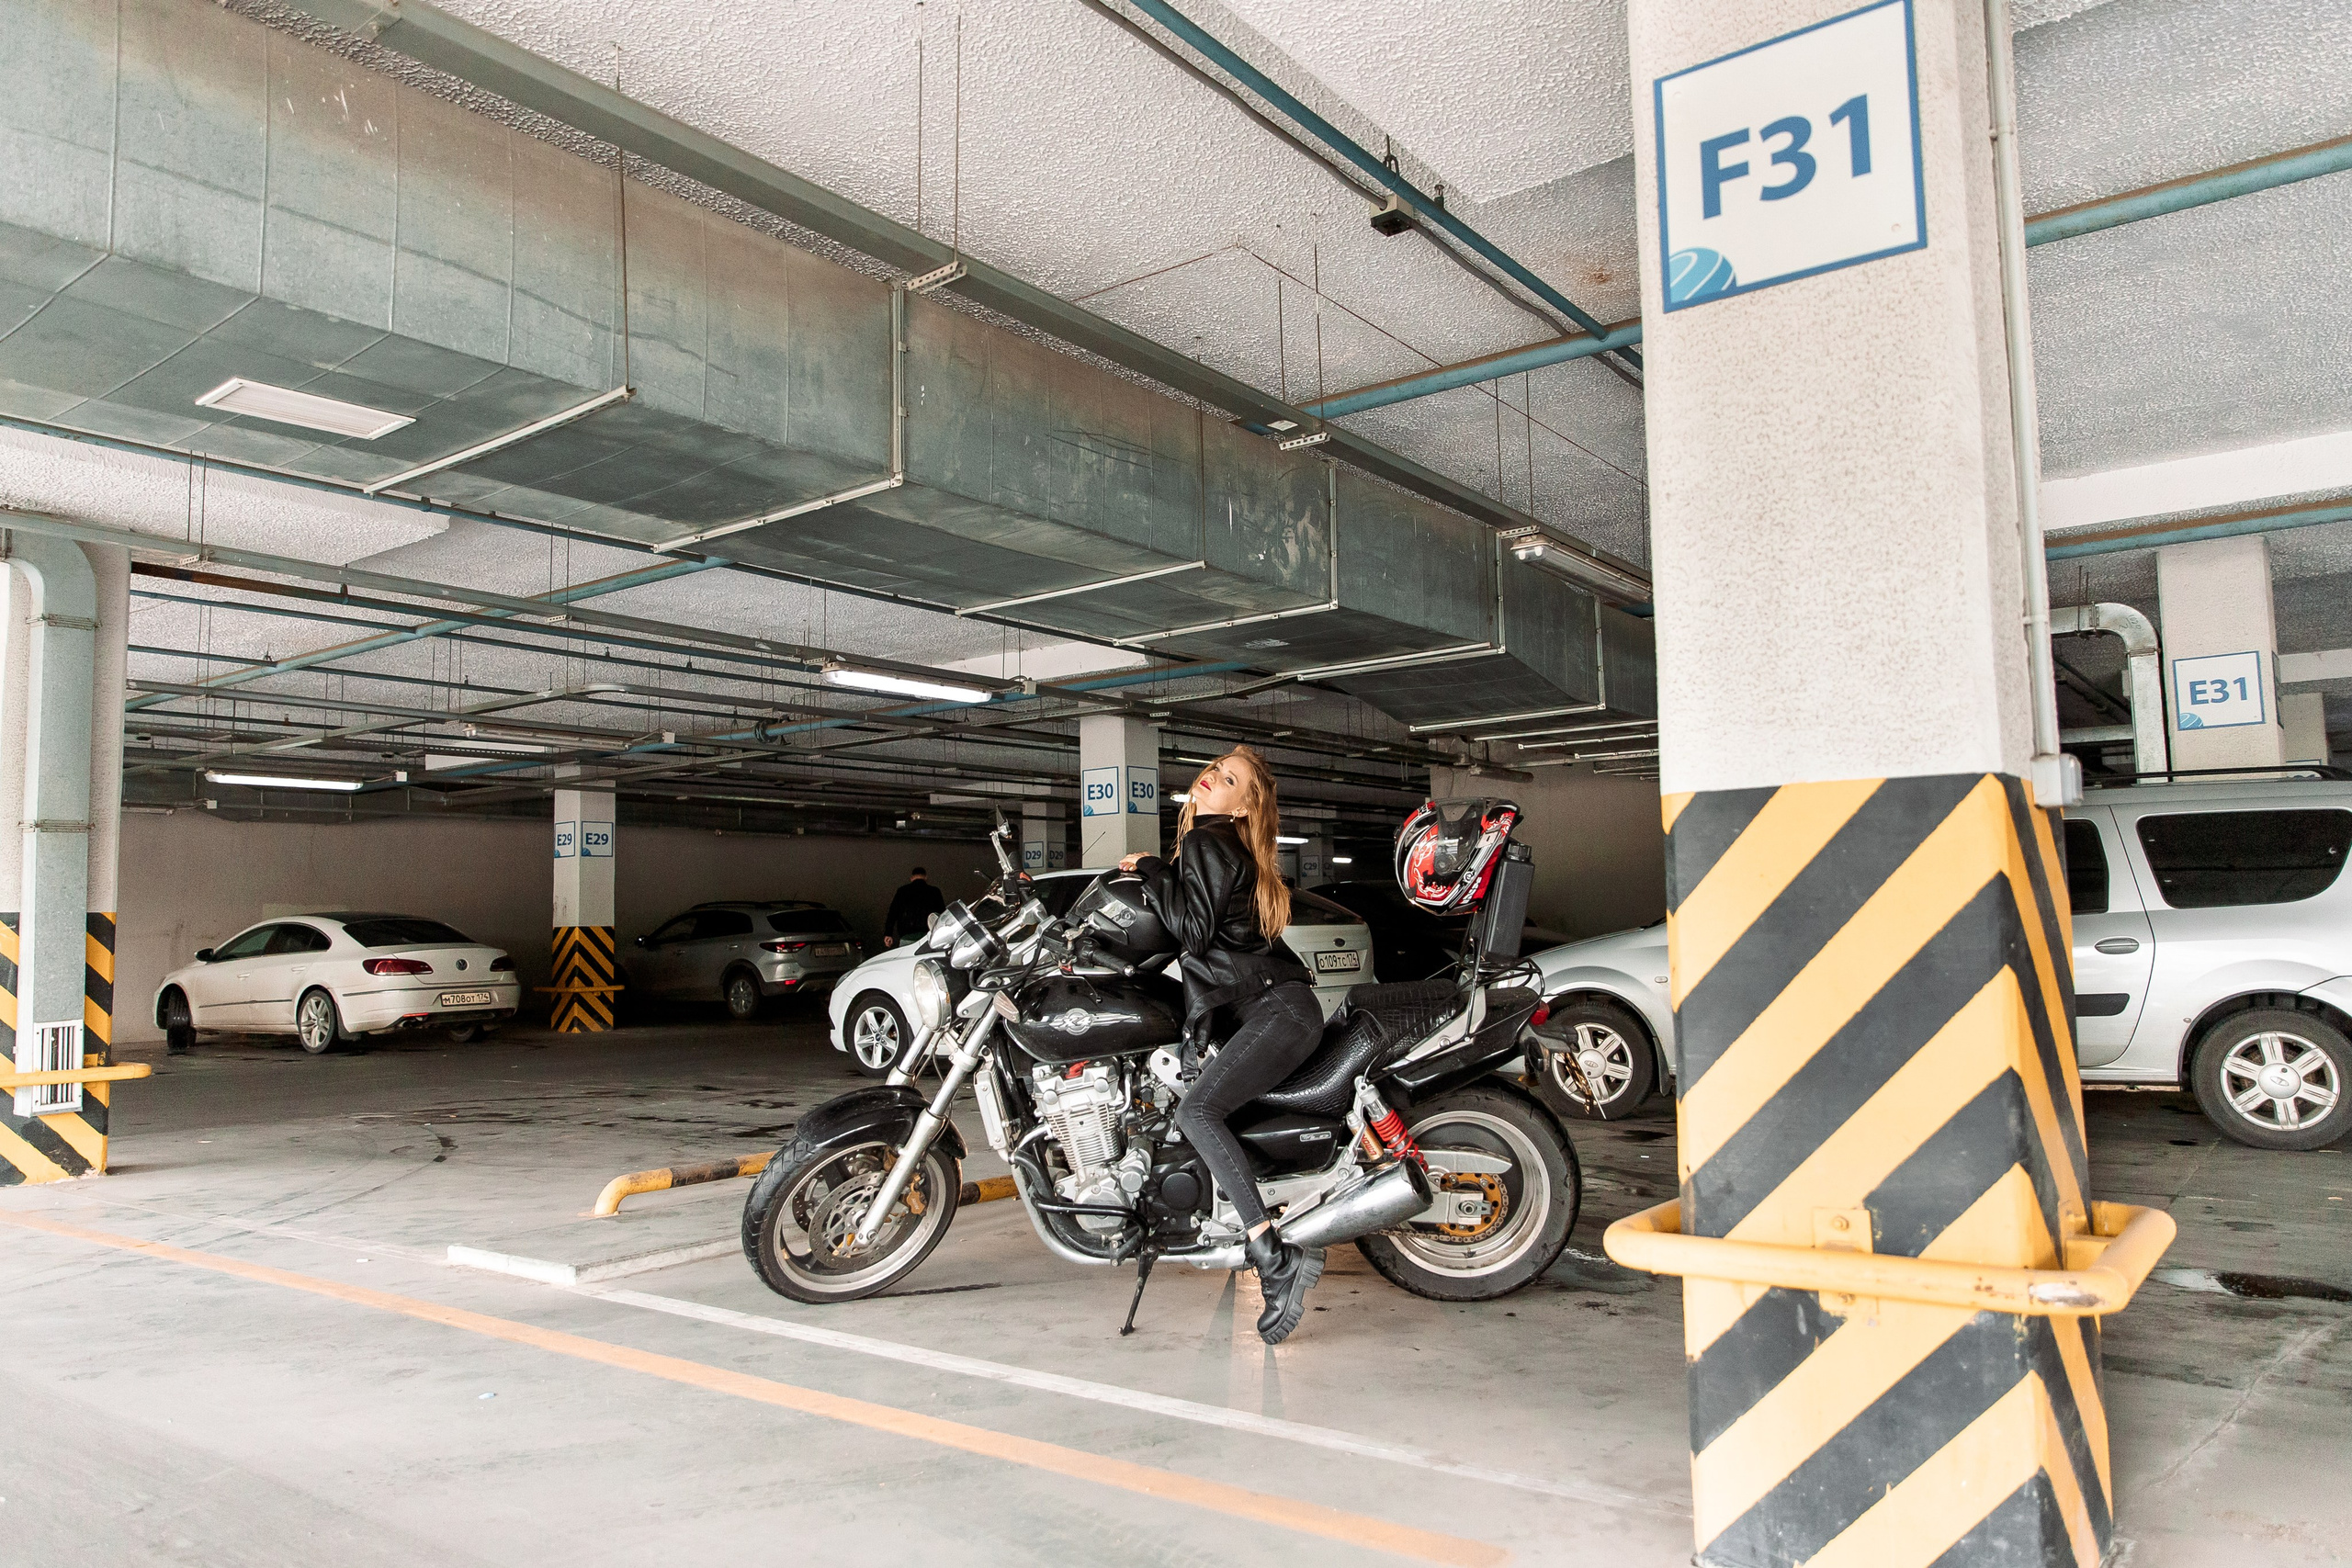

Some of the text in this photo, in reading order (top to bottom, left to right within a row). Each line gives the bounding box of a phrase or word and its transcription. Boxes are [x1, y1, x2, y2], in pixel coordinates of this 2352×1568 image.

[1700, 94, 1871, 220] F31
[2189, 677, 2247, 705] E31
[1088, 783, 1114, 800] E30
[1132, 781, 1154, 799] E30
[557, 833, 572, 846] E29
[585, 832, 609, 845] E29
[1025, 850, 1042, 860] D29
[1049, 850, 1064, 860] D29
[1303, 862, 1317, 870] C29
